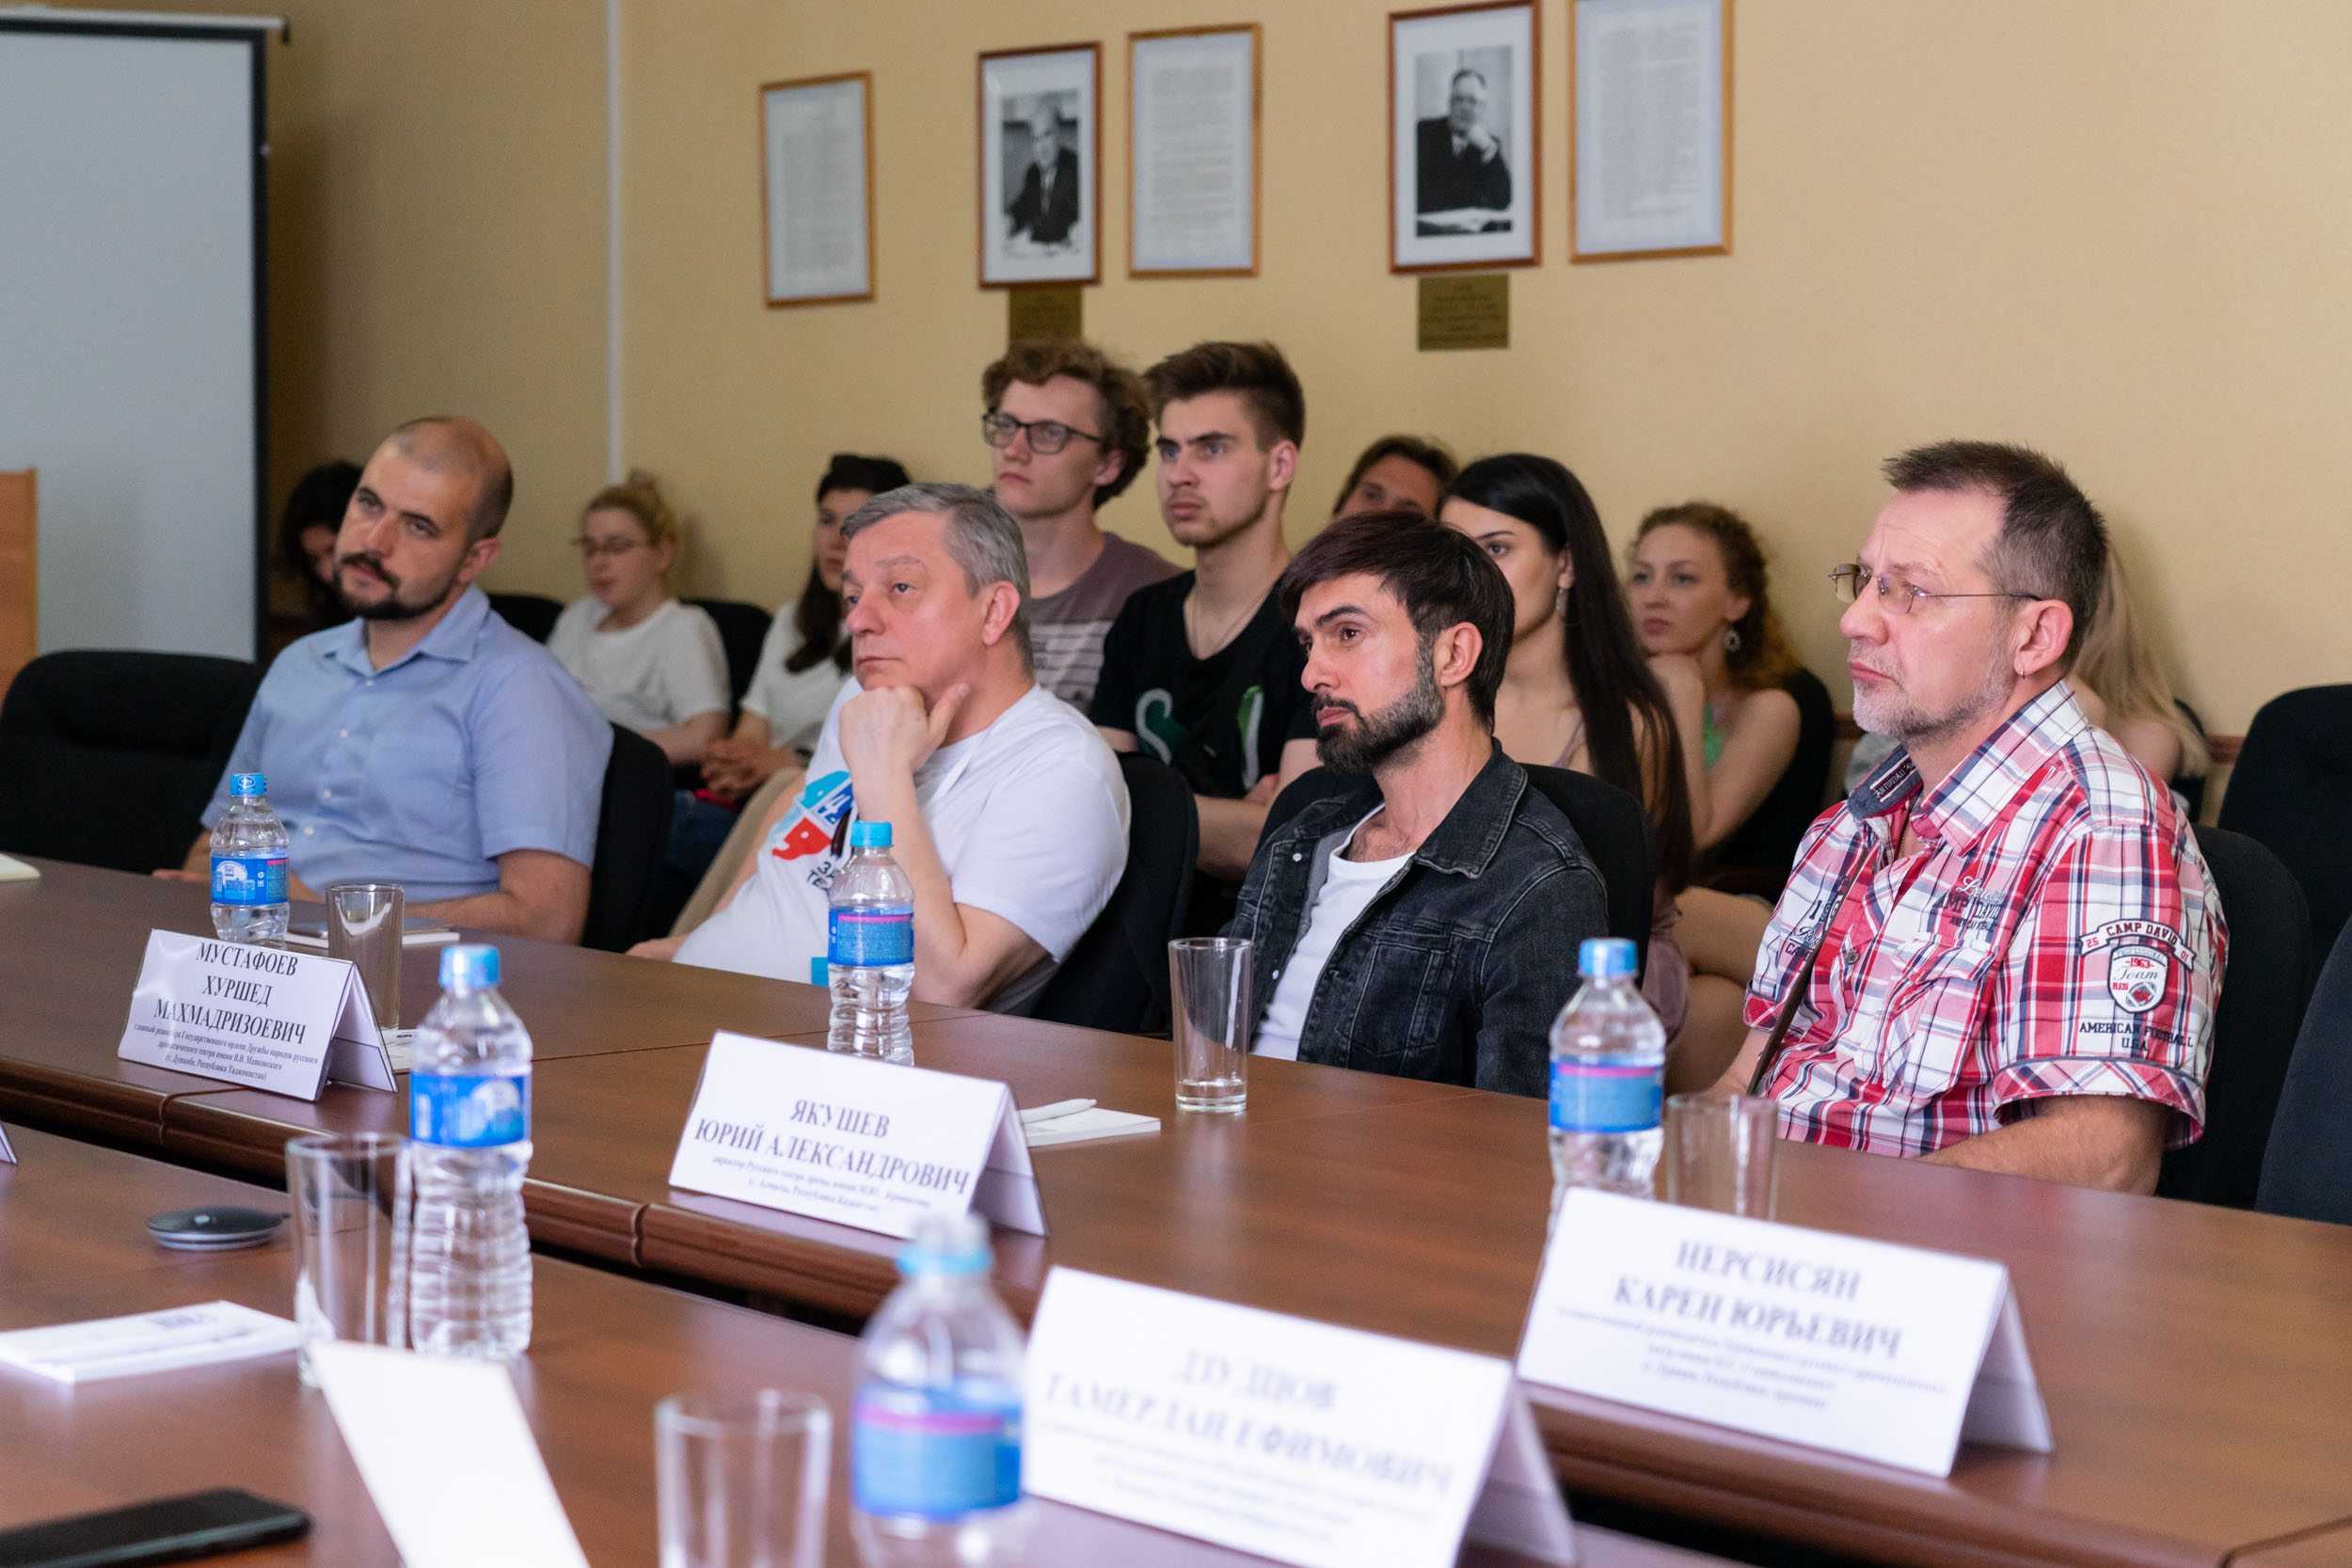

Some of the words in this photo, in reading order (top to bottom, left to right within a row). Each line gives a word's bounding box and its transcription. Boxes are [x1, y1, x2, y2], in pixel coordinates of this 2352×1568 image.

[2106, 923, 2142, 937] CAMP
[2146, 924, 2179, 945] DAVID
[196, 942, 298, 976] МУСТАФОЕВ
[2114, 966, 2158, 980] Team
[202, 975, 273, 1007] ХУРШЕД
[153, 999, 307, 1044] МАХМАДРИЗОЕВИЧ
[2079, 1022, 2142, 1035] AMERICAN
[789, 1099, 892, 1139] ЯКУШЕВ
[694, 1118, 766, 1152] ЮРИЙ
[764, 1135, 970, 1195] АЛЕКСАНДРОВИЧ
[1676, 1240, 1863, 1302] НЕРСИСЯН
[1613, 1275, 1723, 1324] КАРЕН
[1728, 1296, 1903, 1360] ЮРЬЕВИЧ
